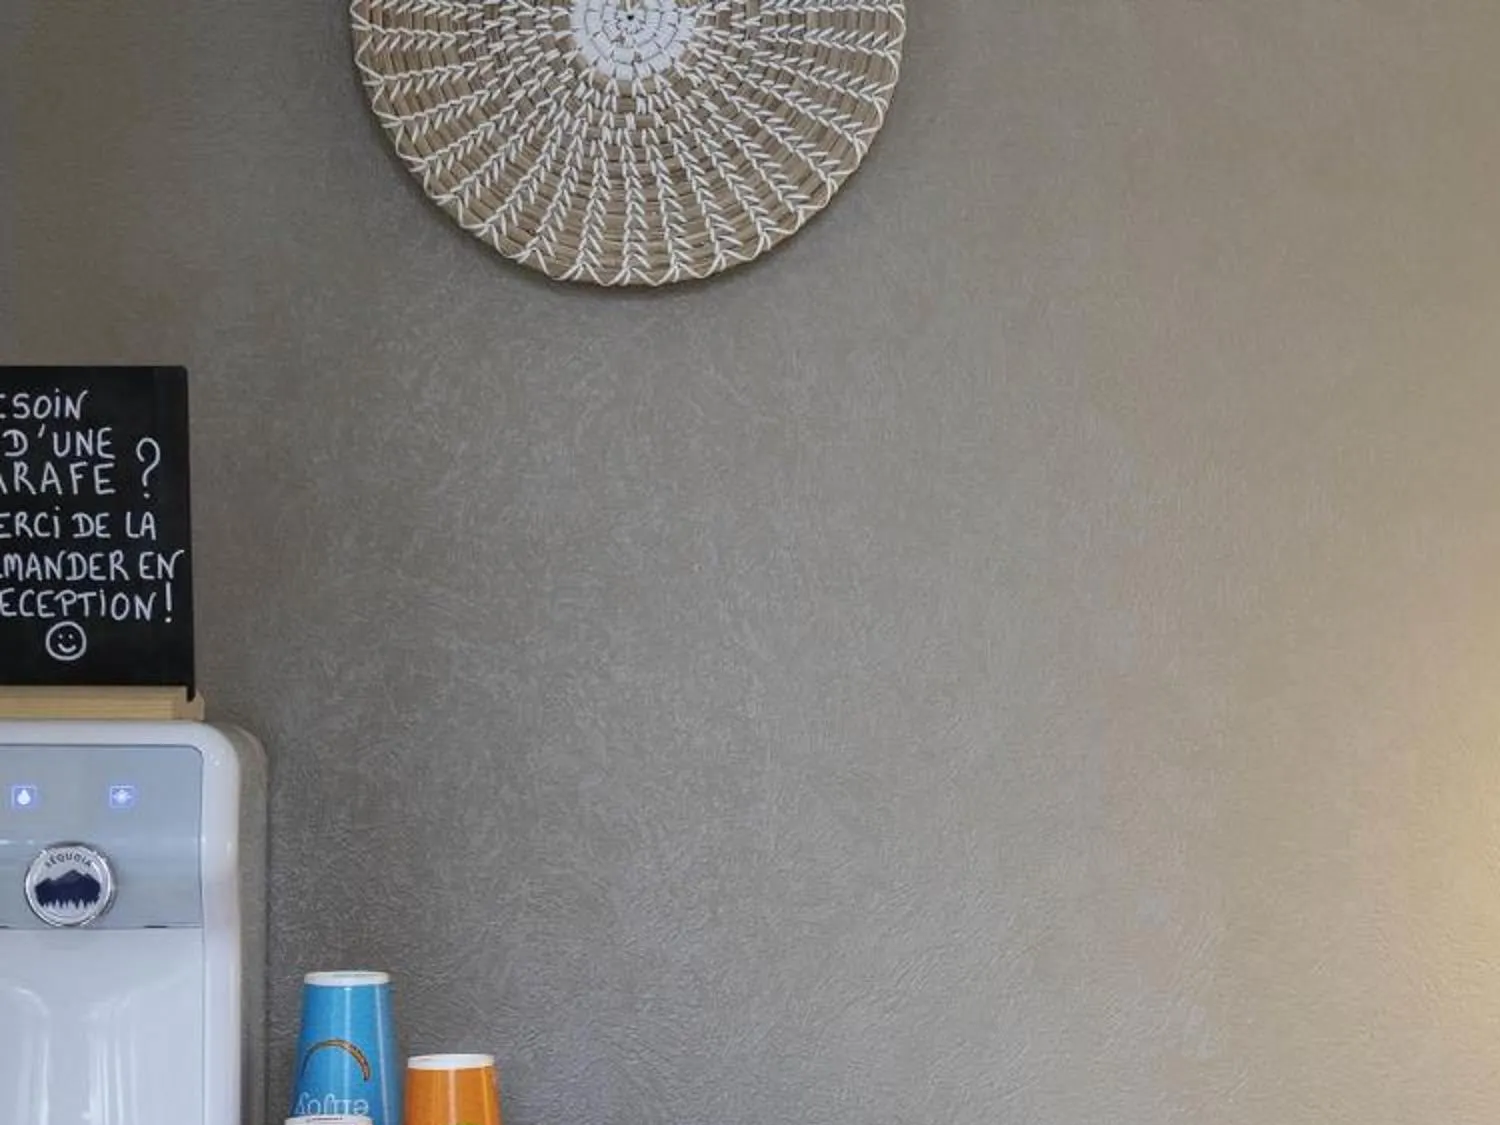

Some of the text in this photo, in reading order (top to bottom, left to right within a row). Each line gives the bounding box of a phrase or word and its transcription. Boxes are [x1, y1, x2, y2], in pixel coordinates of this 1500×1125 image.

[72, 512, 112, 539] DE
[125, 511, 157, 541] LA
[0, 549, 185, 582] MANDER EN
